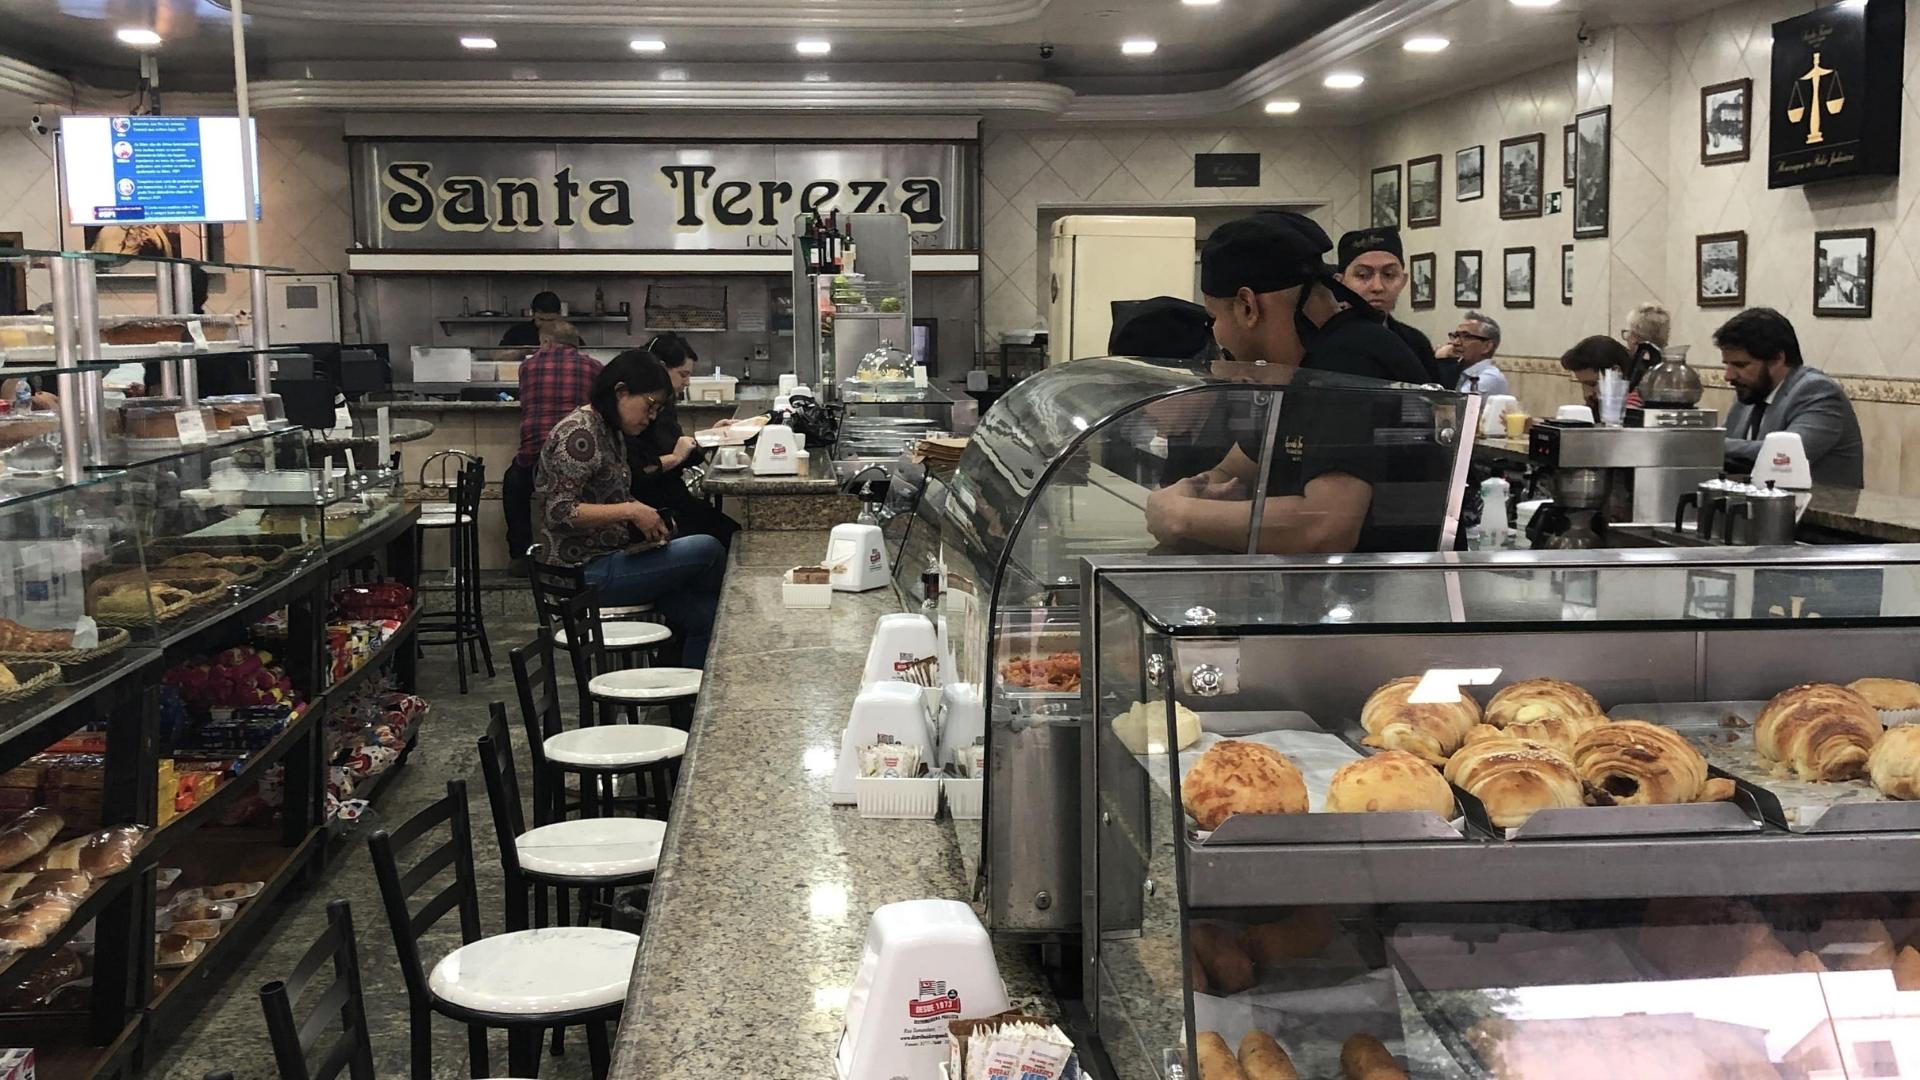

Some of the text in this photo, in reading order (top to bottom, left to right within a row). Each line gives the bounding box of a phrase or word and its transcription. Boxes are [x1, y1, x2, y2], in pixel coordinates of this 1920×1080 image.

[383, 163, 945, 231] Santa Tereza
[915, 1003, 935, 1014] DESDE
